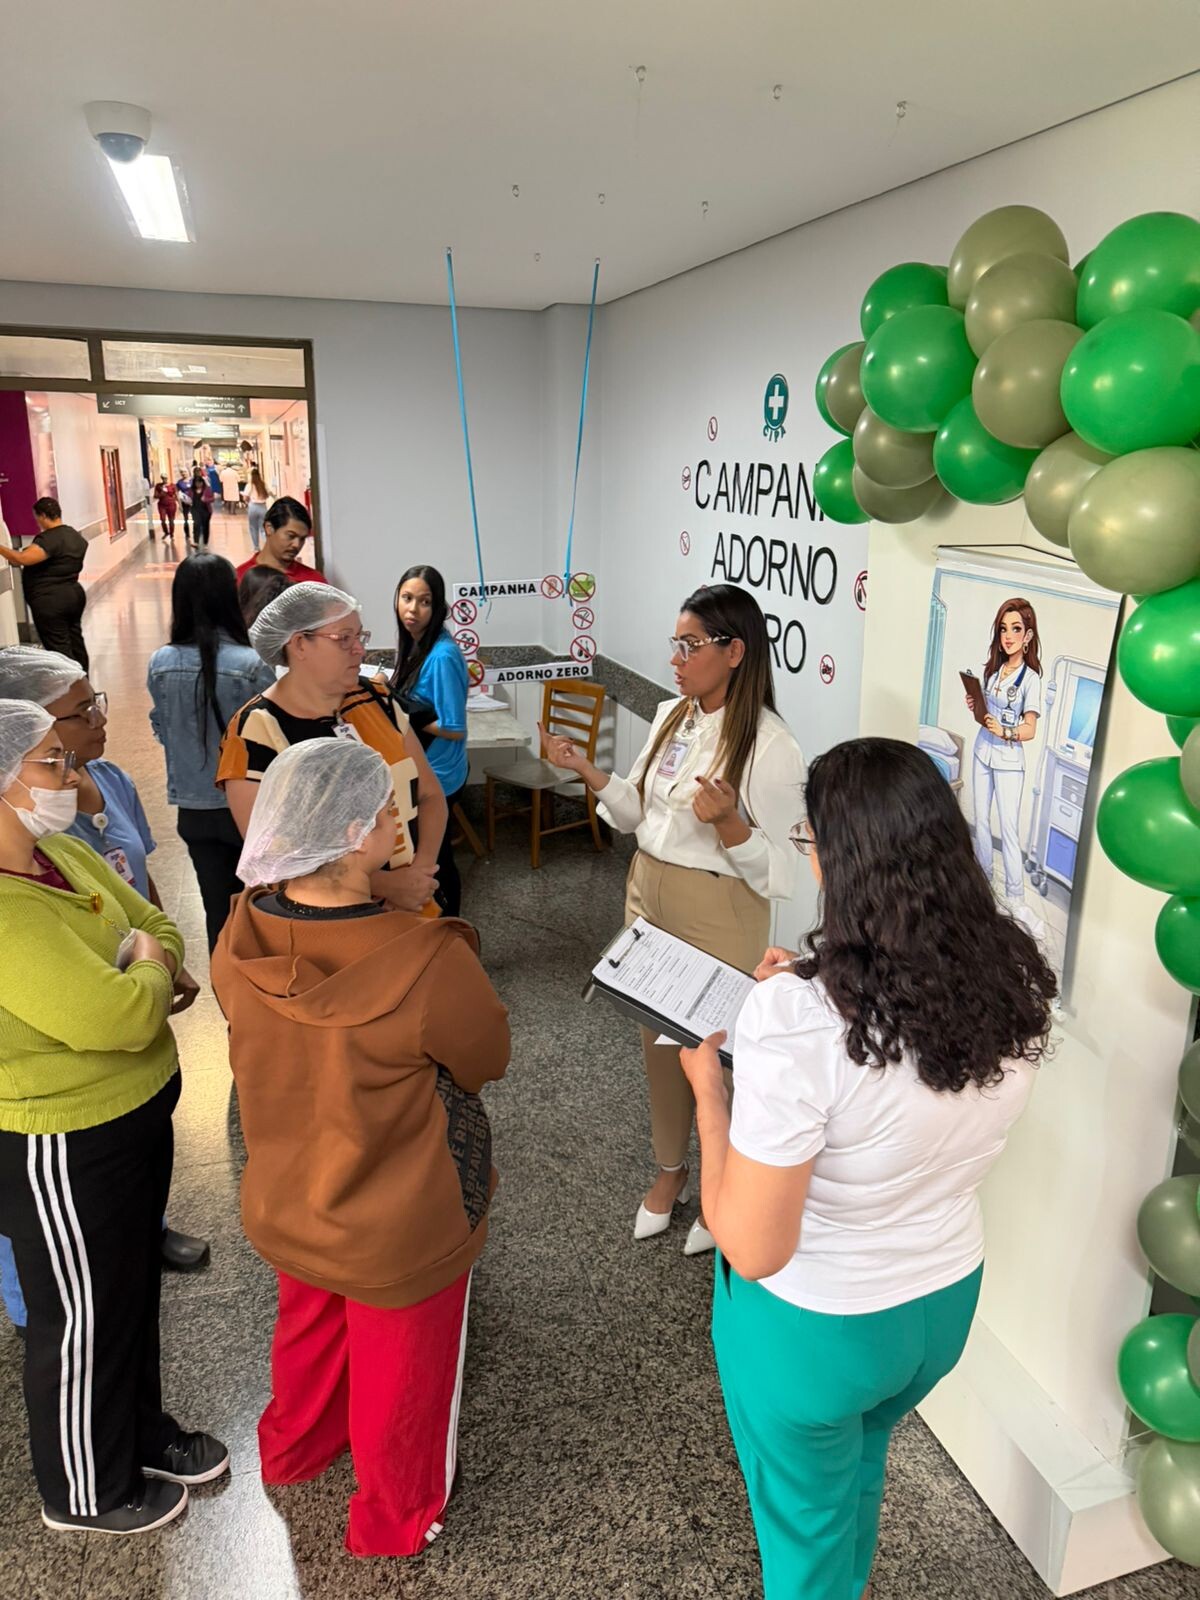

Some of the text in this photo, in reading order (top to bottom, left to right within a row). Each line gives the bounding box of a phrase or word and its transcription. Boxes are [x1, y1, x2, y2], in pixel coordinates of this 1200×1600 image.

[695, 459, 825, 522] CAMPAN
[459, 583, 536, 597] CAMPANHA
[711, 532, 837, 605] ADORNO
[497, 665, 589, 682] ADORNO ZERO
[764, 613, 806, 674] RO
